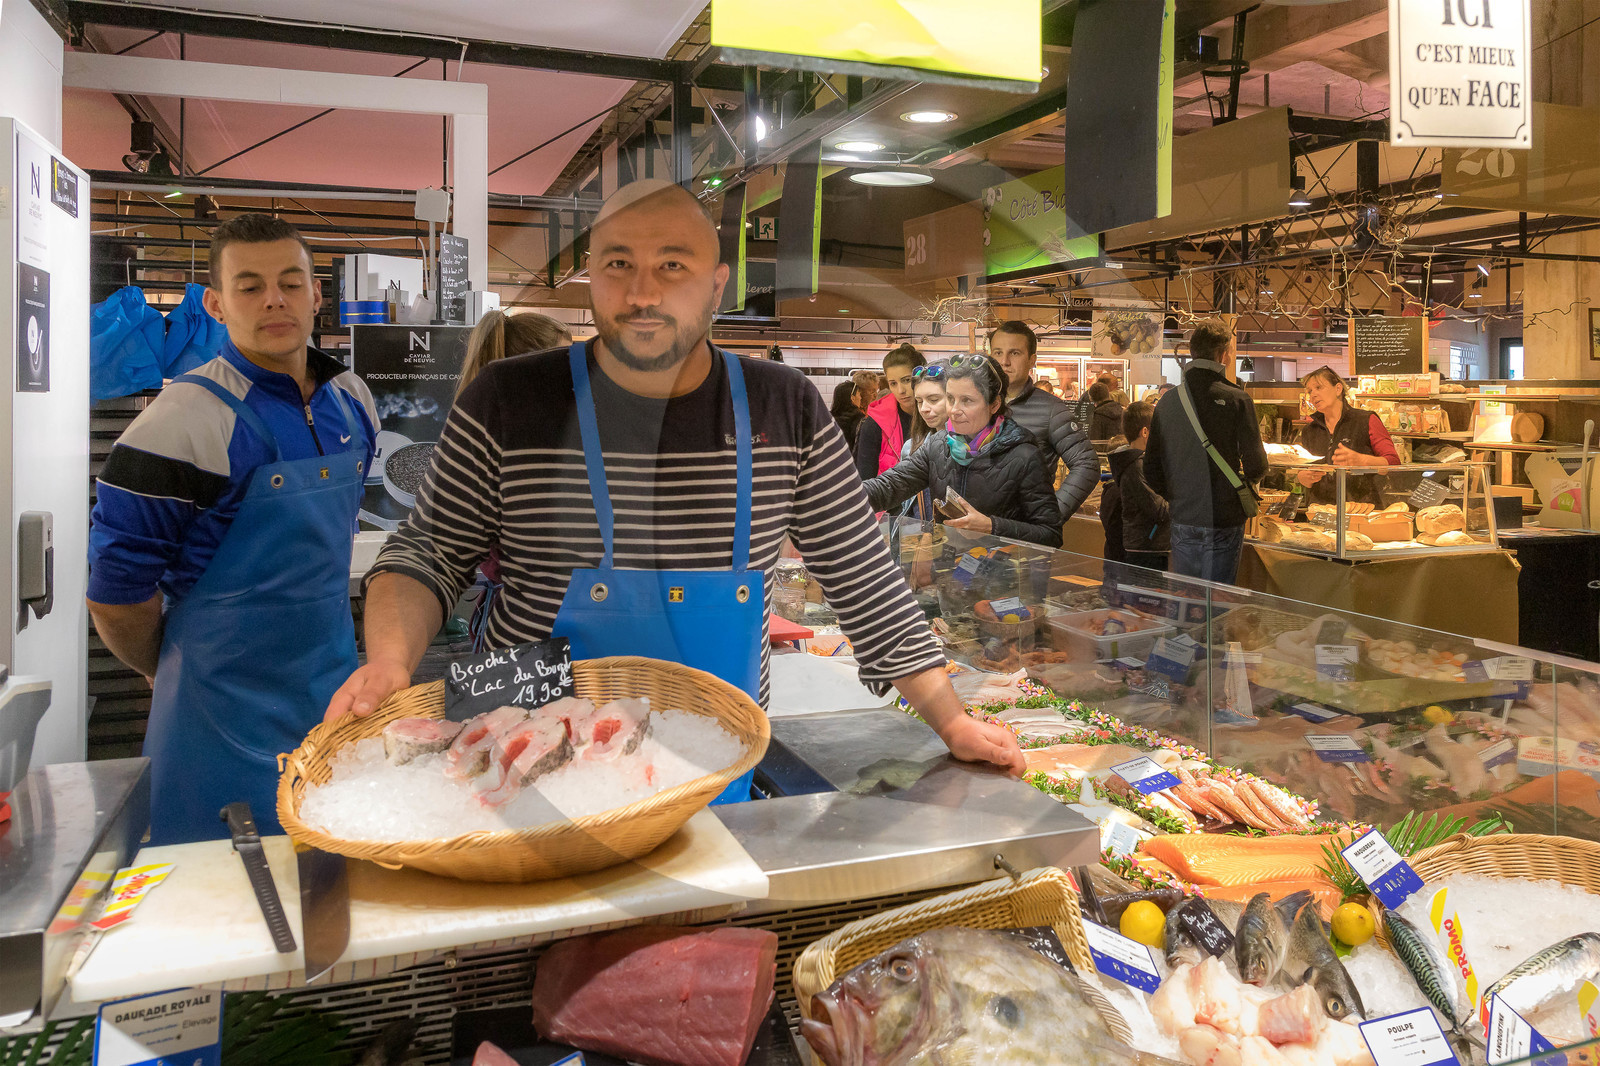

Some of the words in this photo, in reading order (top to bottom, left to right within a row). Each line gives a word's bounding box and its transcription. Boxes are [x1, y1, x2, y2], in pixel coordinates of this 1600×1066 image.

[1416, 43, 1463, 63] C'EST
[1468, 46, 1515, 67] MIEUX
[1408, 86, 1461, 109] QU'EN
[1466, 80, 1520, 108] FACE
[1009, 194, 1038, 222] Côté
[907, 233, 927, 266] 28
[745, 283, 774, 293] leret
[409, 331, 430, 351] N
[408, 373, 438, 381] FRANÇAIS
[451, 648, 519, 681] Brochet
[514, 667, 534, 684] du
[1354, 840, 1376, 857] MAQUEREAU
[1443, 919, 1472, 980] PROMO
[115, 1004, 168, 1024] DAURADE
[170, 994, 212, 1013] ROYALE
[182, 1015, 218, 1030] Elevage
[1387, 1022, 1415, 1034] POULPE
